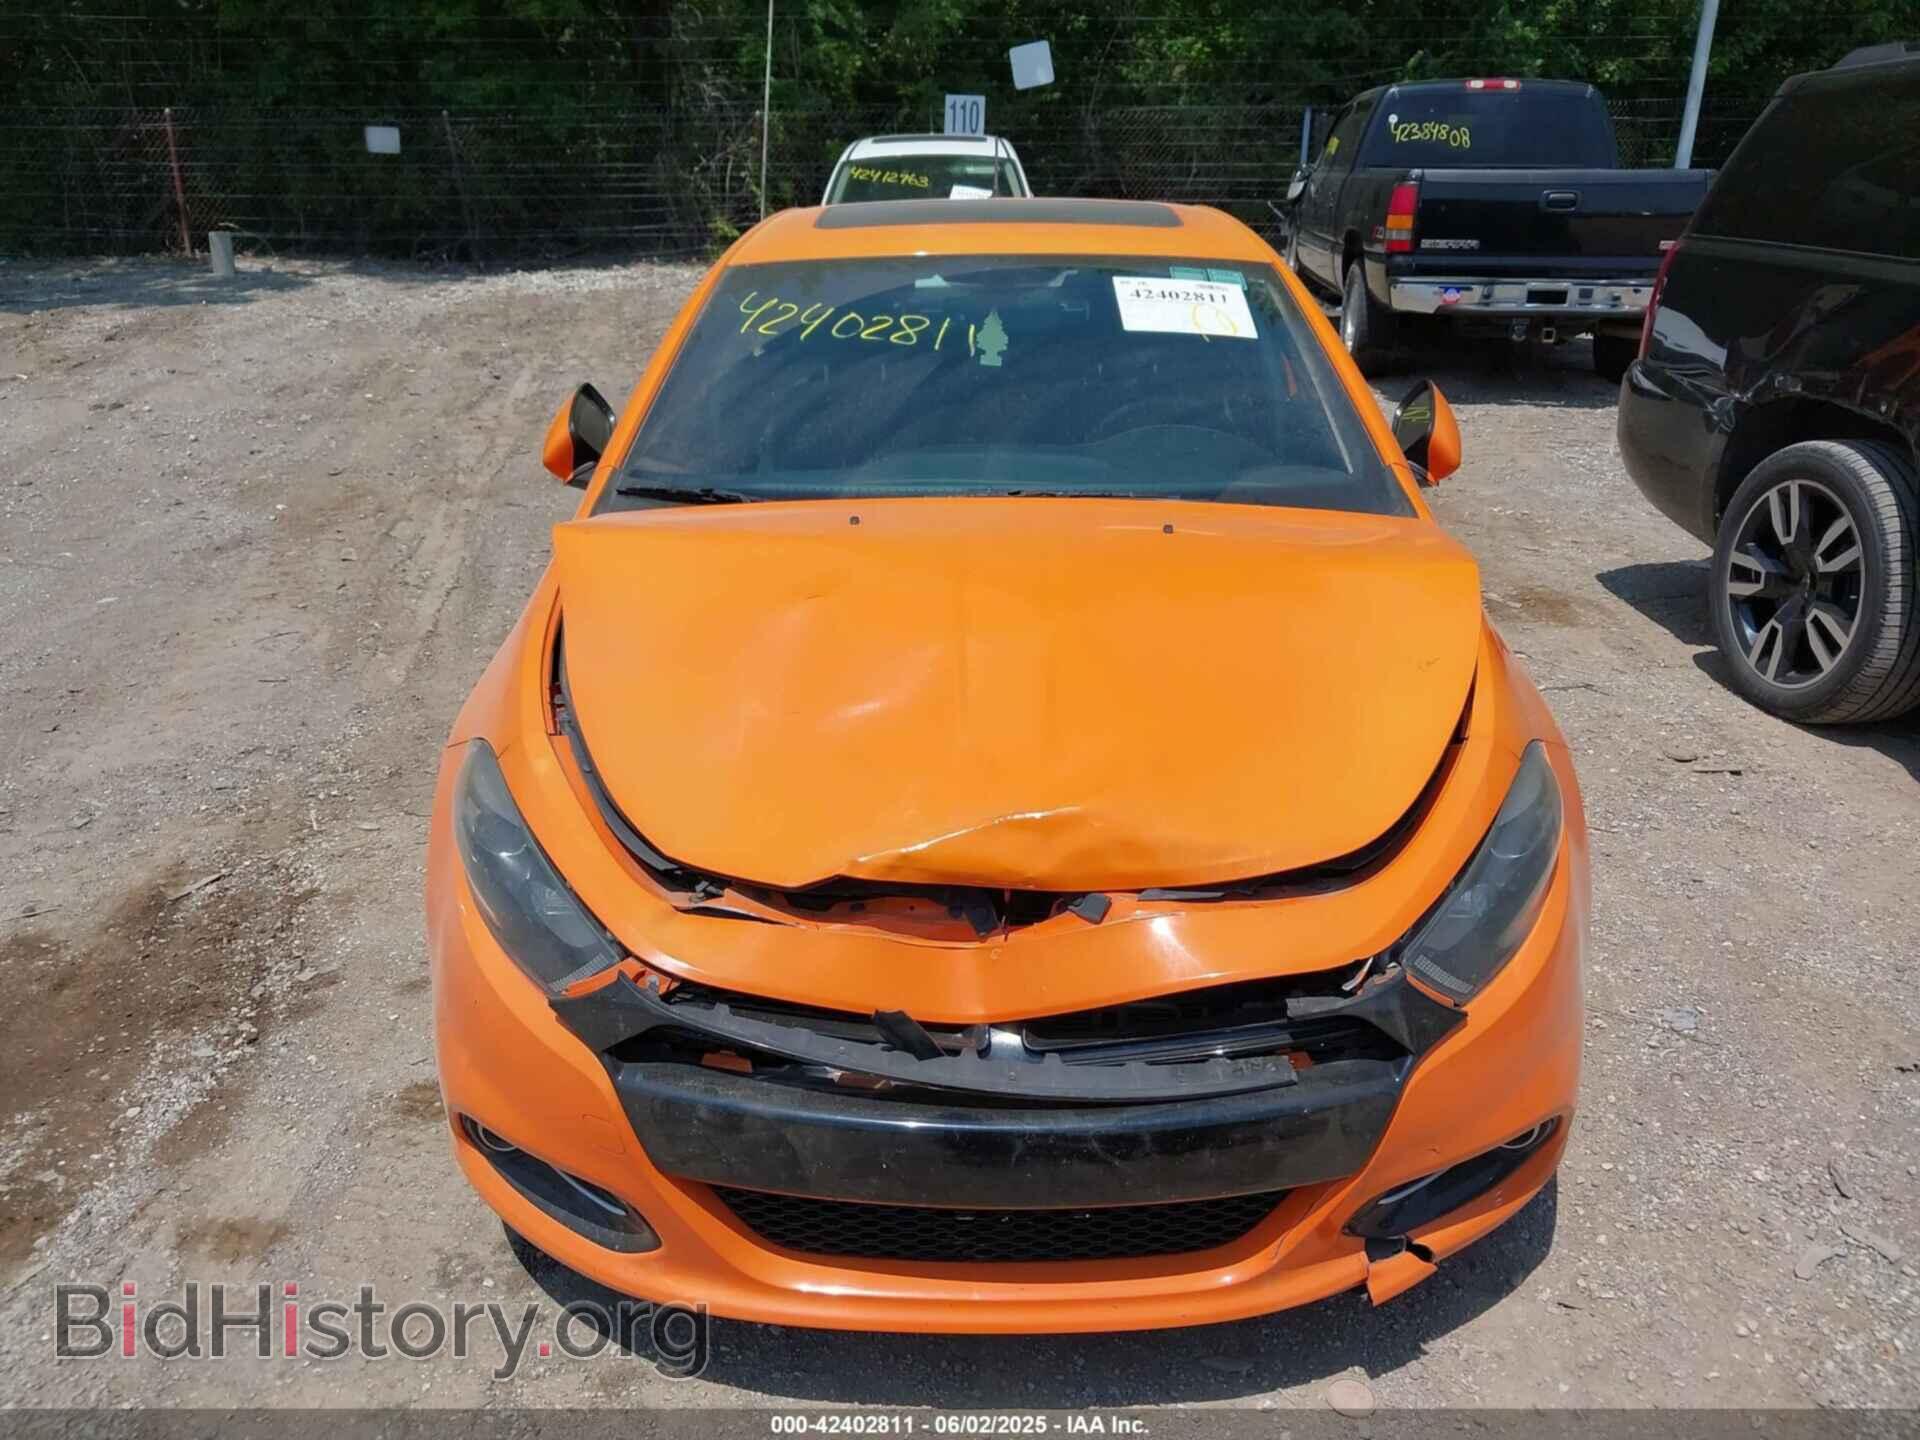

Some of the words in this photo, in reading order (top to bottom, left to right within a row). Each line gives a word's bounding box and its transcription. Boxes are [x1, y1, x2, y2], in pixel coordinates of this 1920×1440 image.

[950, 101, 980, 133] 110
[1391, 120, 1471, 148] 42384808
[1130, 287, 1229, 304] 42402811
[739, 291, 976, 358] 42402811
